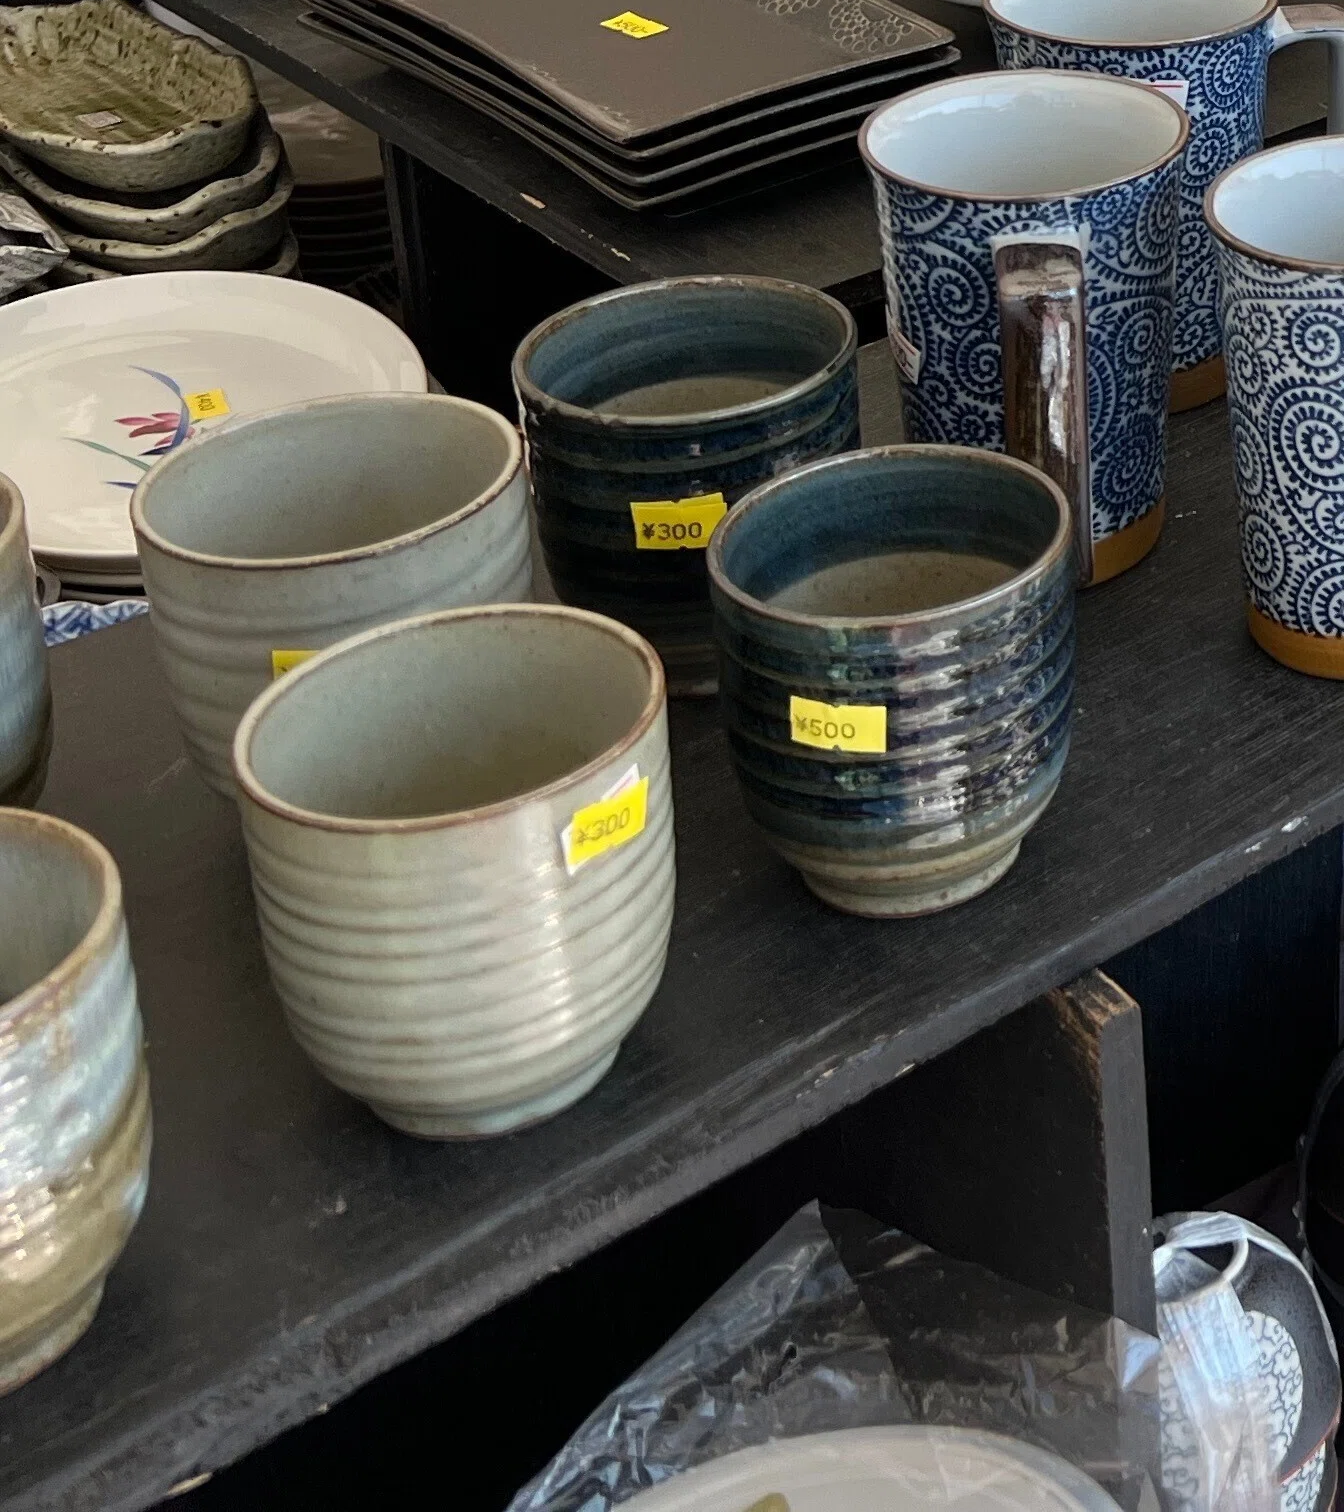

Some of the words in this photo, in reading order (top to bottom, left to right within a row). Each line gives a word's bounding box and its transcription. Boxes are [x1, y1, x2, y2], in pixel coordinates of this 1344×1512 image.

[642, 522, 703, 541] ¥300
[793, 716, 857, 740] ¥500
[575, 806, 632, 847] ¥300
